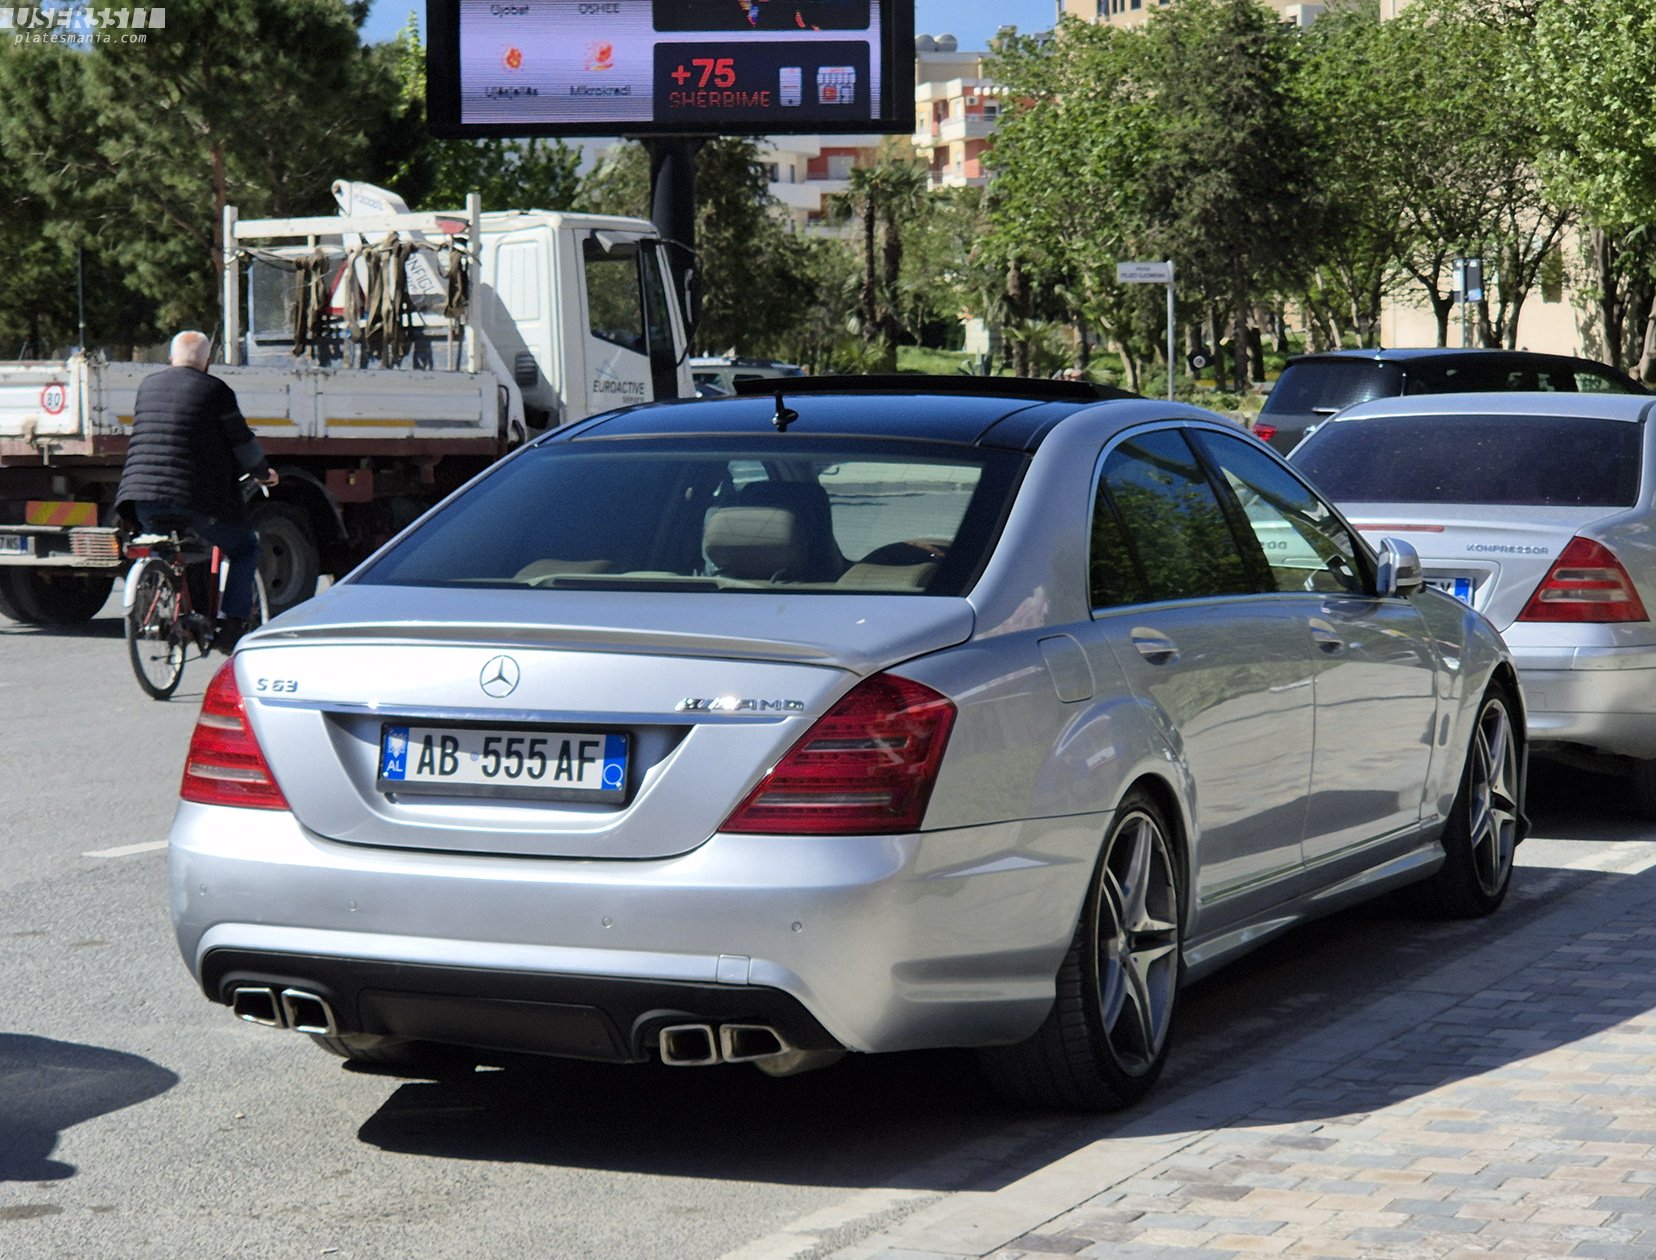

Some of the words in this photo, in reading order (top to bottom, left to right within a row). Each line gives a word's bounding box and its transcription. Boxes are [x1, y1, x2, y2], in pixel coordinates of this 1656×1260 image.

[671, 58, 737, 88] +75
[593, 380, 645, 395] EUROACTIVE
[1466, 544, 1549, 555] KOMPRESSOR
[416, 734, 460, 776] AB
[386, 759, 404, 772] AL
